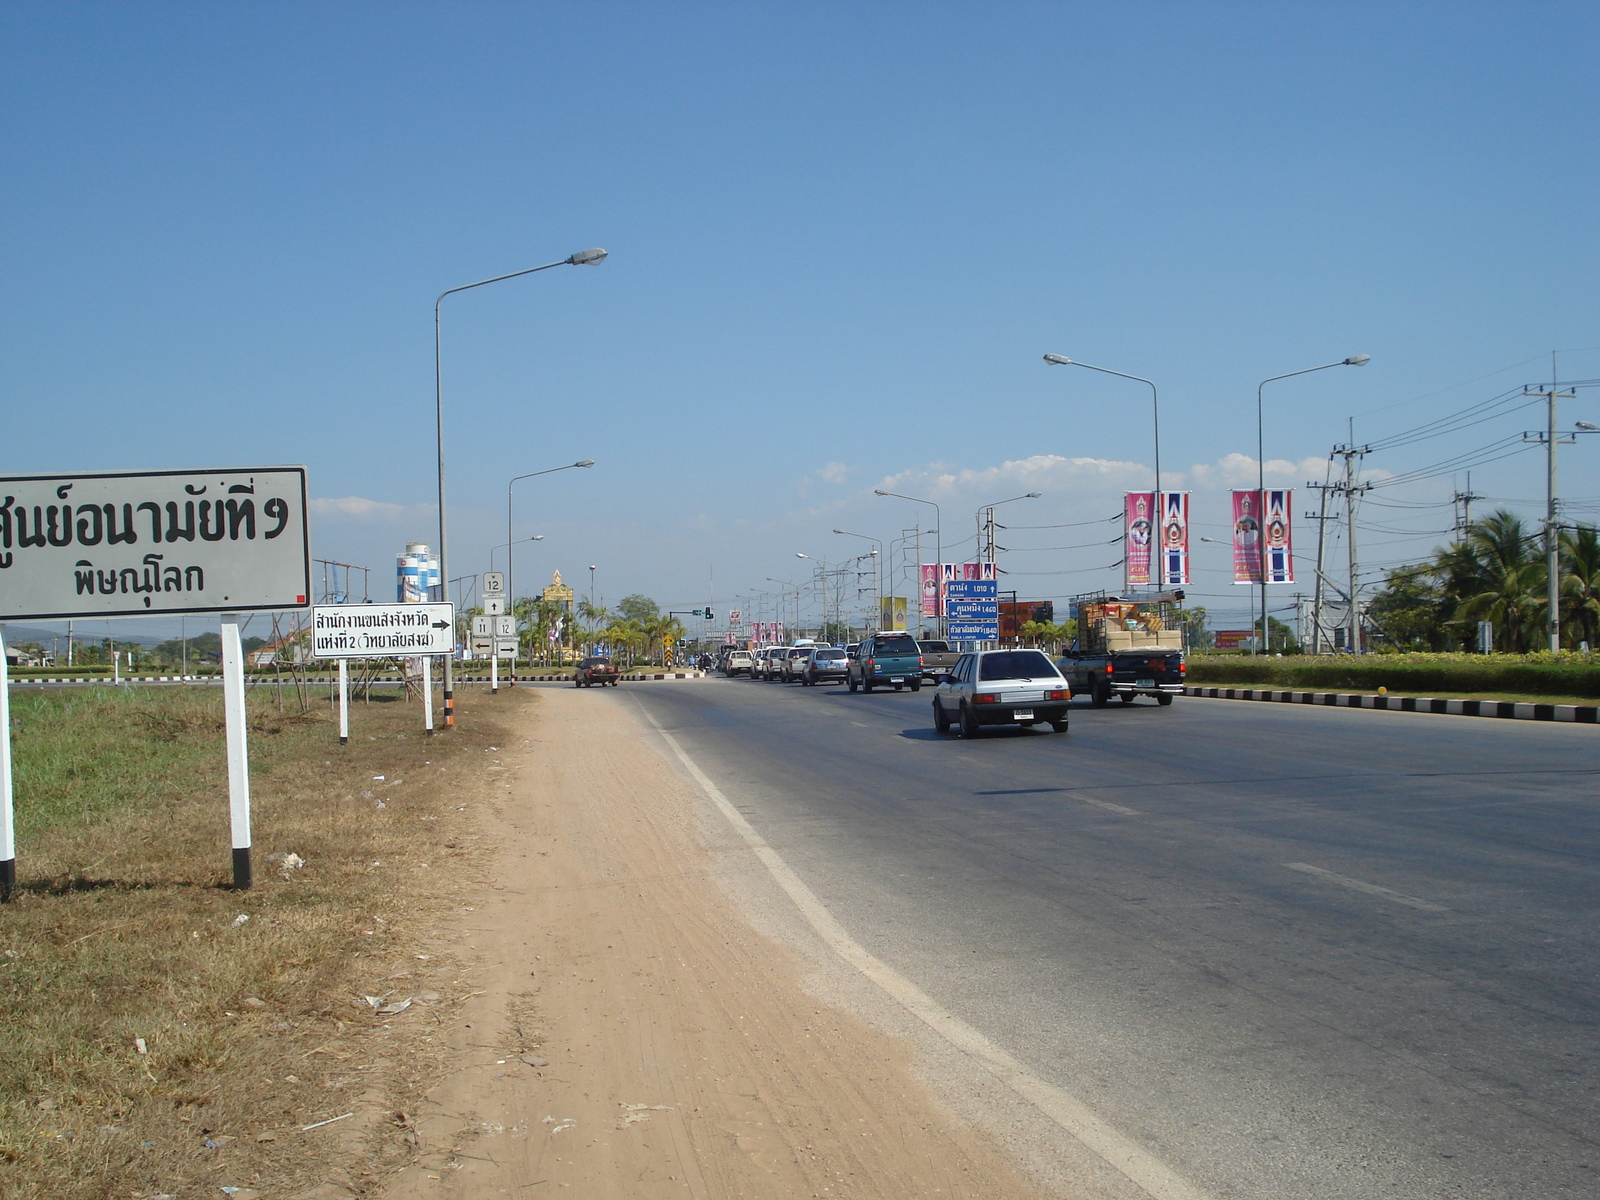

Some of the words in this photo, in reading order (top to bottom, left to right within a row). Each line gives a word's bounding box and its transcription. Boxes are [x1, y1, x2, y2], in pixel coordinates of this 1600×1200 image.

[75, 553, 204, 608] พิษณุโลก
[488, 580, 499, 590] 12
[316, 610, 429, 629] สำนักงานขนส่งจังหวัด
[479, 624, 486, 633] 11
[502, 624, 510, 633] 12
[317, 629, 348, 649] แห่งที่
[357, 630, 434, 650] (วิทยาลัยสงฆ์)
